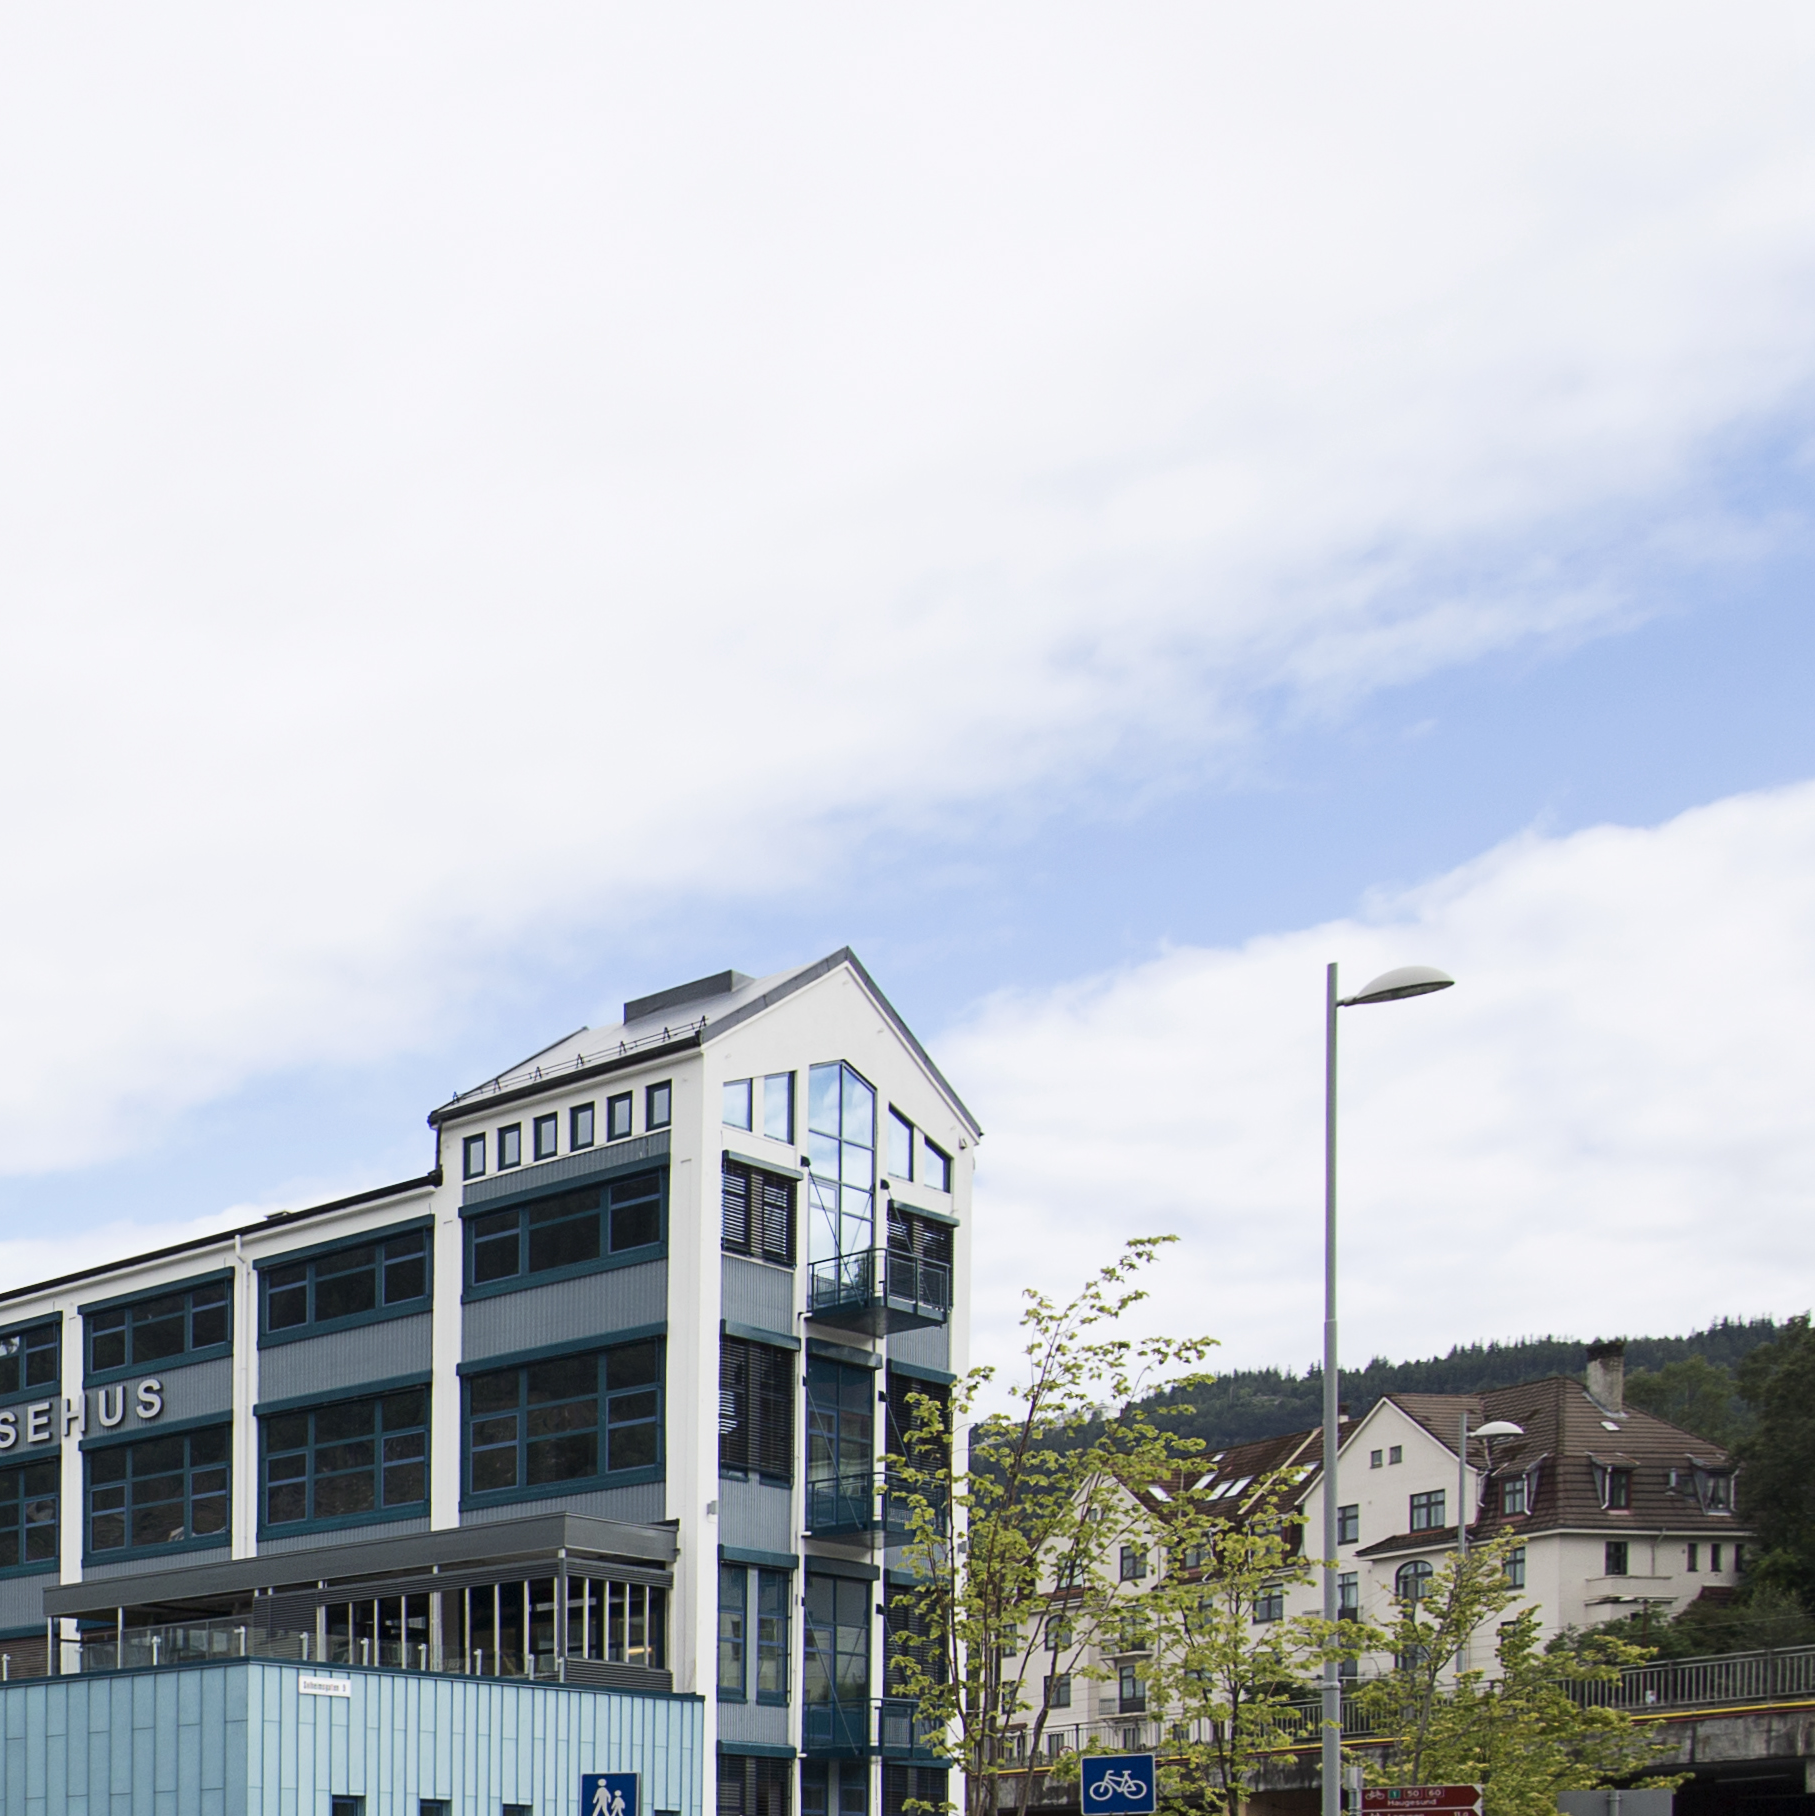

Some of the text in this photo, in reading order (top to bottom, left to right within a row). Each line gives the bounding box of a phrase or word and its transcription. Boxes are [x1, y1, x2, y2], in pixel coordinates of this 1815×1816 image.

[1407, 1790, 1419, 1798] 50
[1428, 1788, 1441, 1797] 60
[1387, 1799, 1437, 1807] Haugesund
